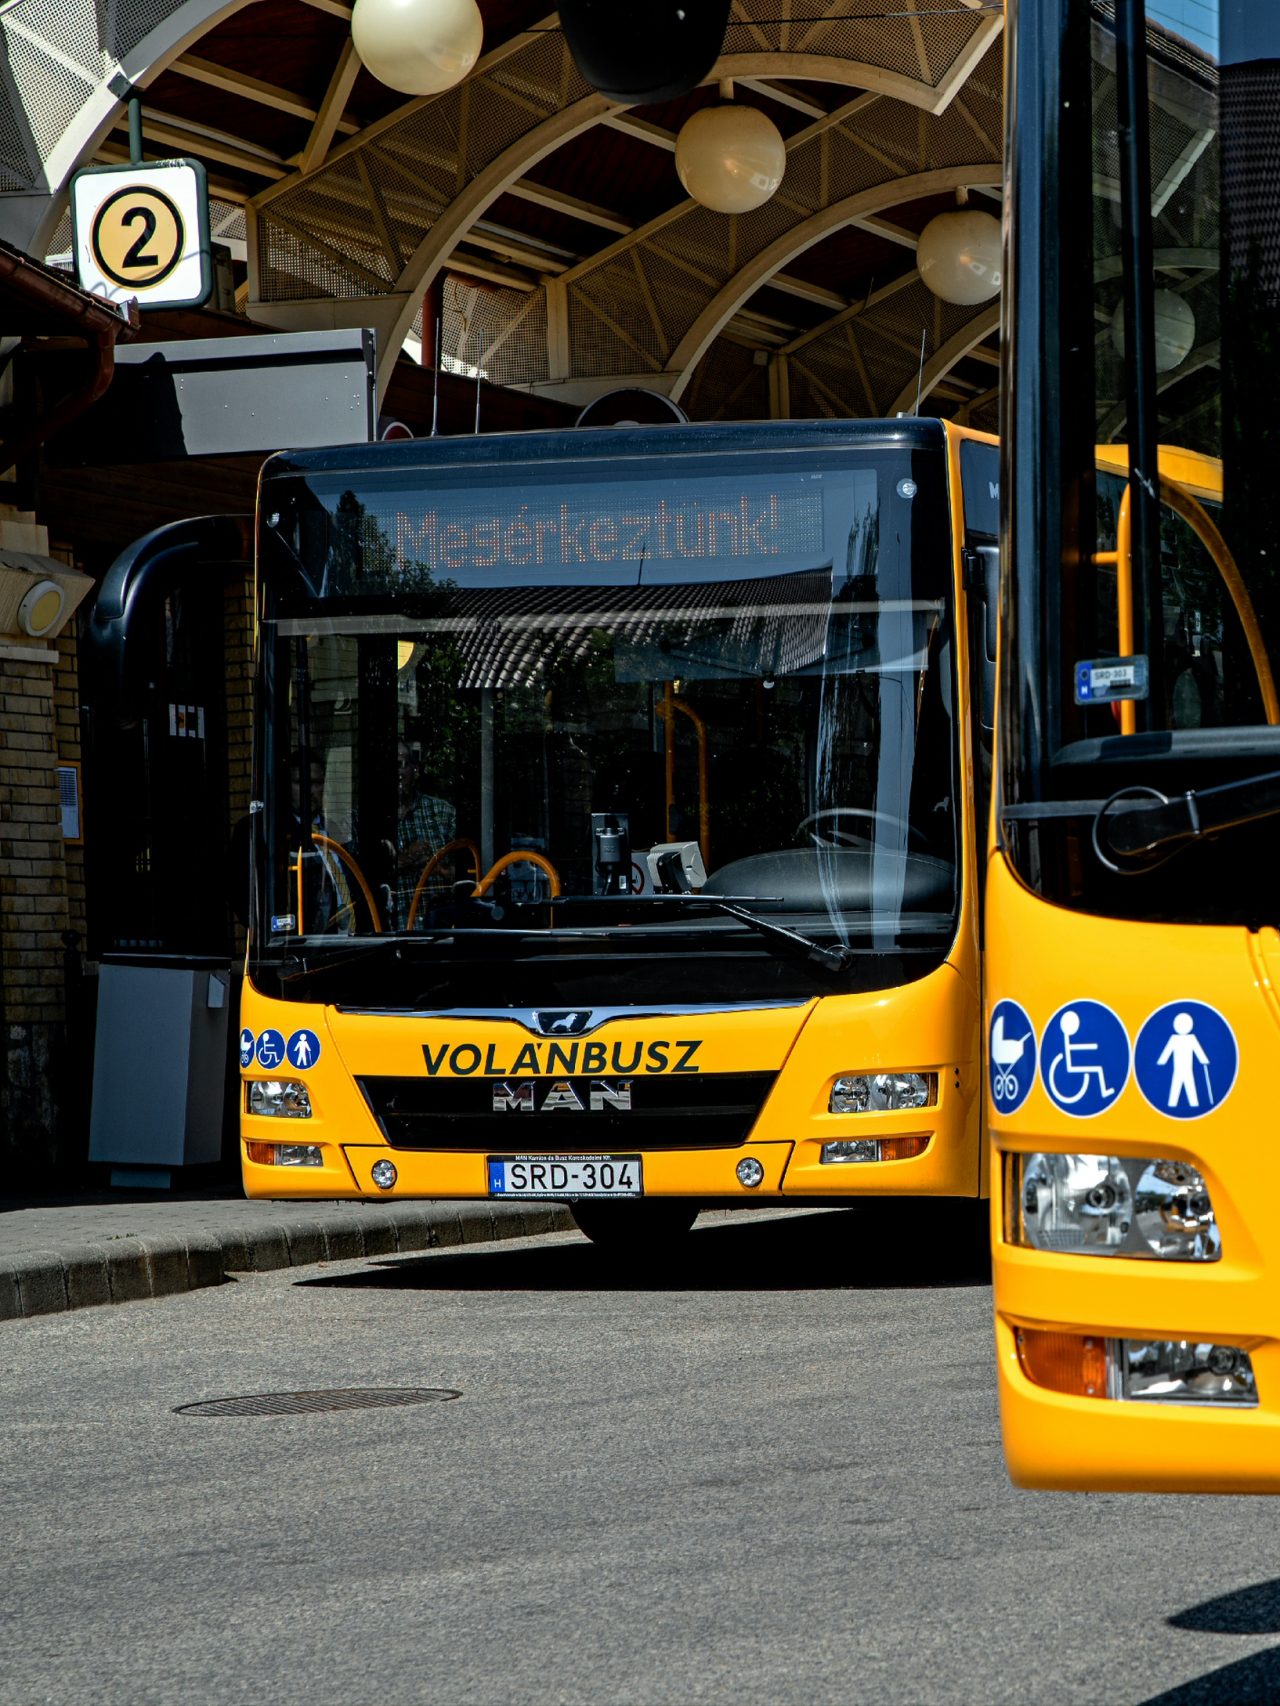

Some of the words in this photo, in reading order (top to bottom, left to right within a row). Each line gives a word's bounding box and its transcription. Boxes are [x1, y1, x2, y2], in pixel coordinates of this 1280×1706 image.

[121, 206, 158, 268] 2
[396, 495, 779, 569] Megérkeztünk!
[422, 1040, 703, 1075] VOLÁNBUSZ
[492, 1080, 634, 1112] MAN
[494, 1179, 501, 1188] H
[511, 1164, 633, 1189] SRD-304
